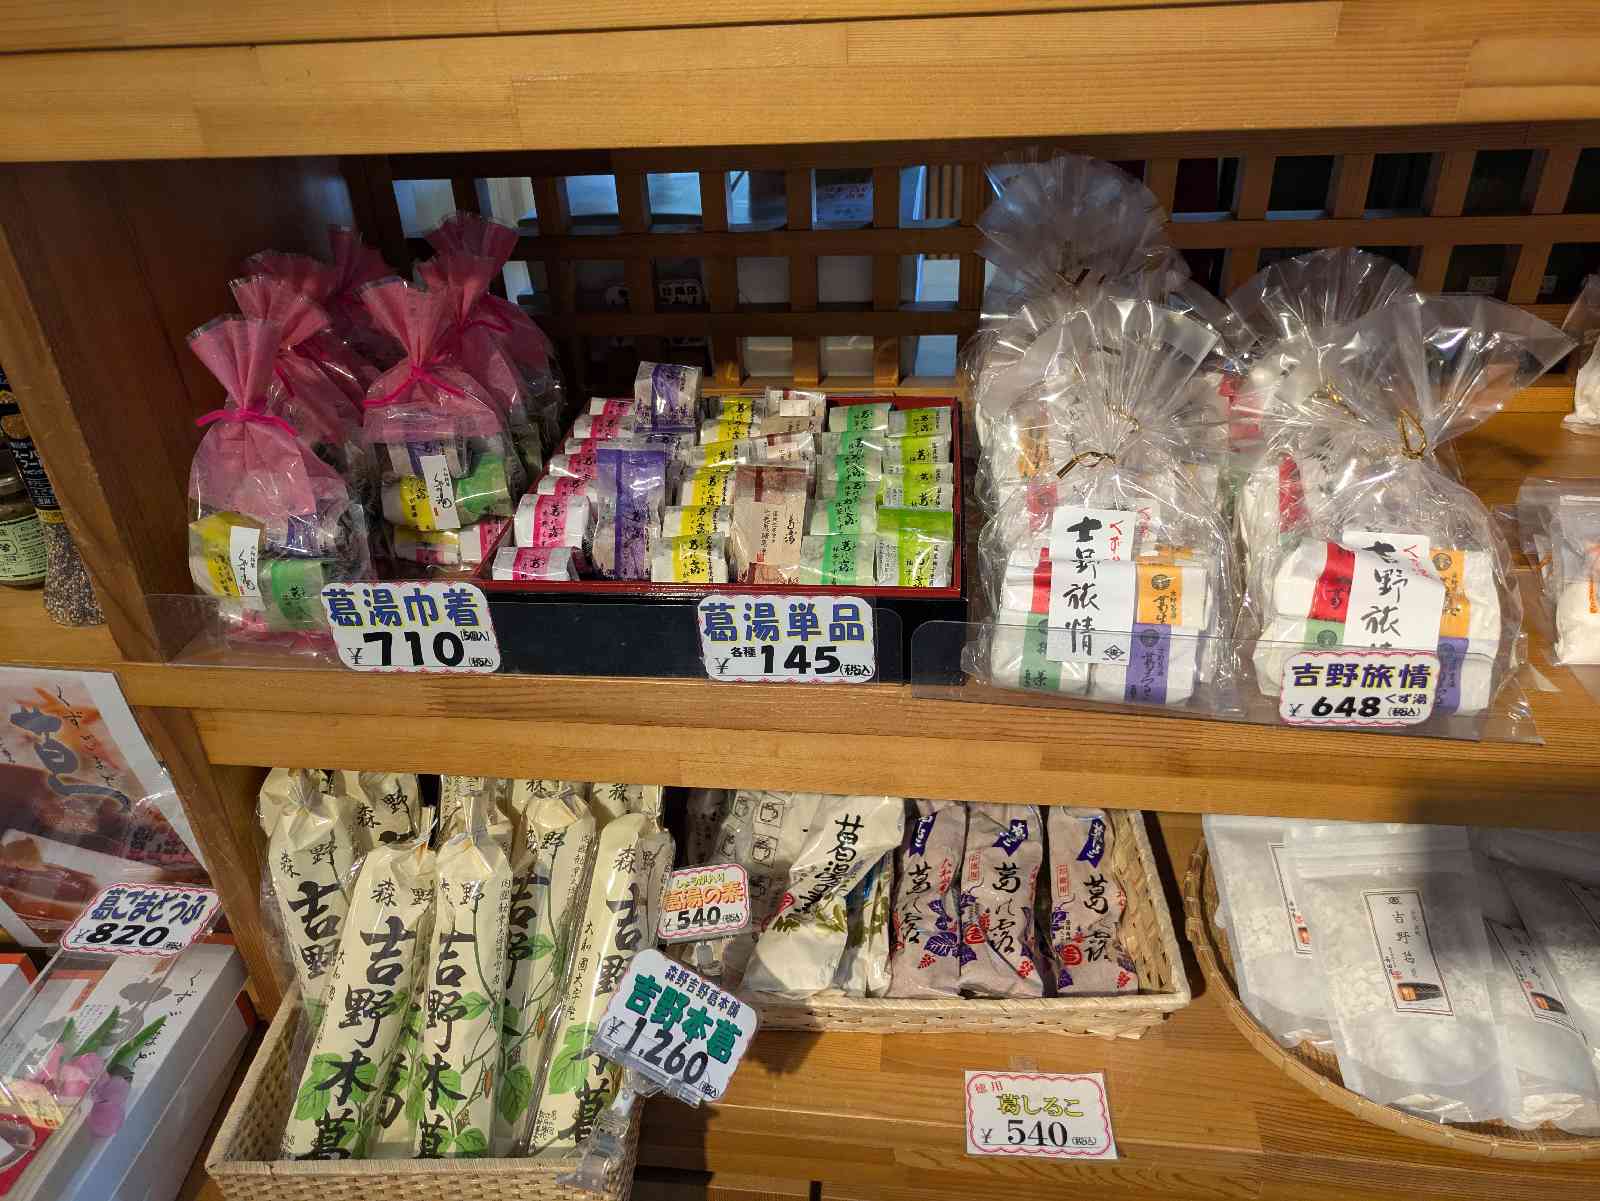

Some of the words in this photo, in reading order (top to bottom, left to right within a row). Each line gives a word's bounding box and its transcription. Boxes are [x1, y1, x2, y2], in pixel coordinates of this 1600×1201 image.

[322, 589, 480, 628] 葛湯巾着
[700, 602, 865, 642] 葛湯単品
[730, 646, 757, 658] 各種
[1291, 662, 1431, 690] 吉野旅情
[91, 886, 209, 926] 葛ごまどうふ
[663, 879, 744, 912] 葛湯の素
[625, 973, 743, 1064] 吉野本葛
[996, 1092, 1085, 1118] 葛しるこ
